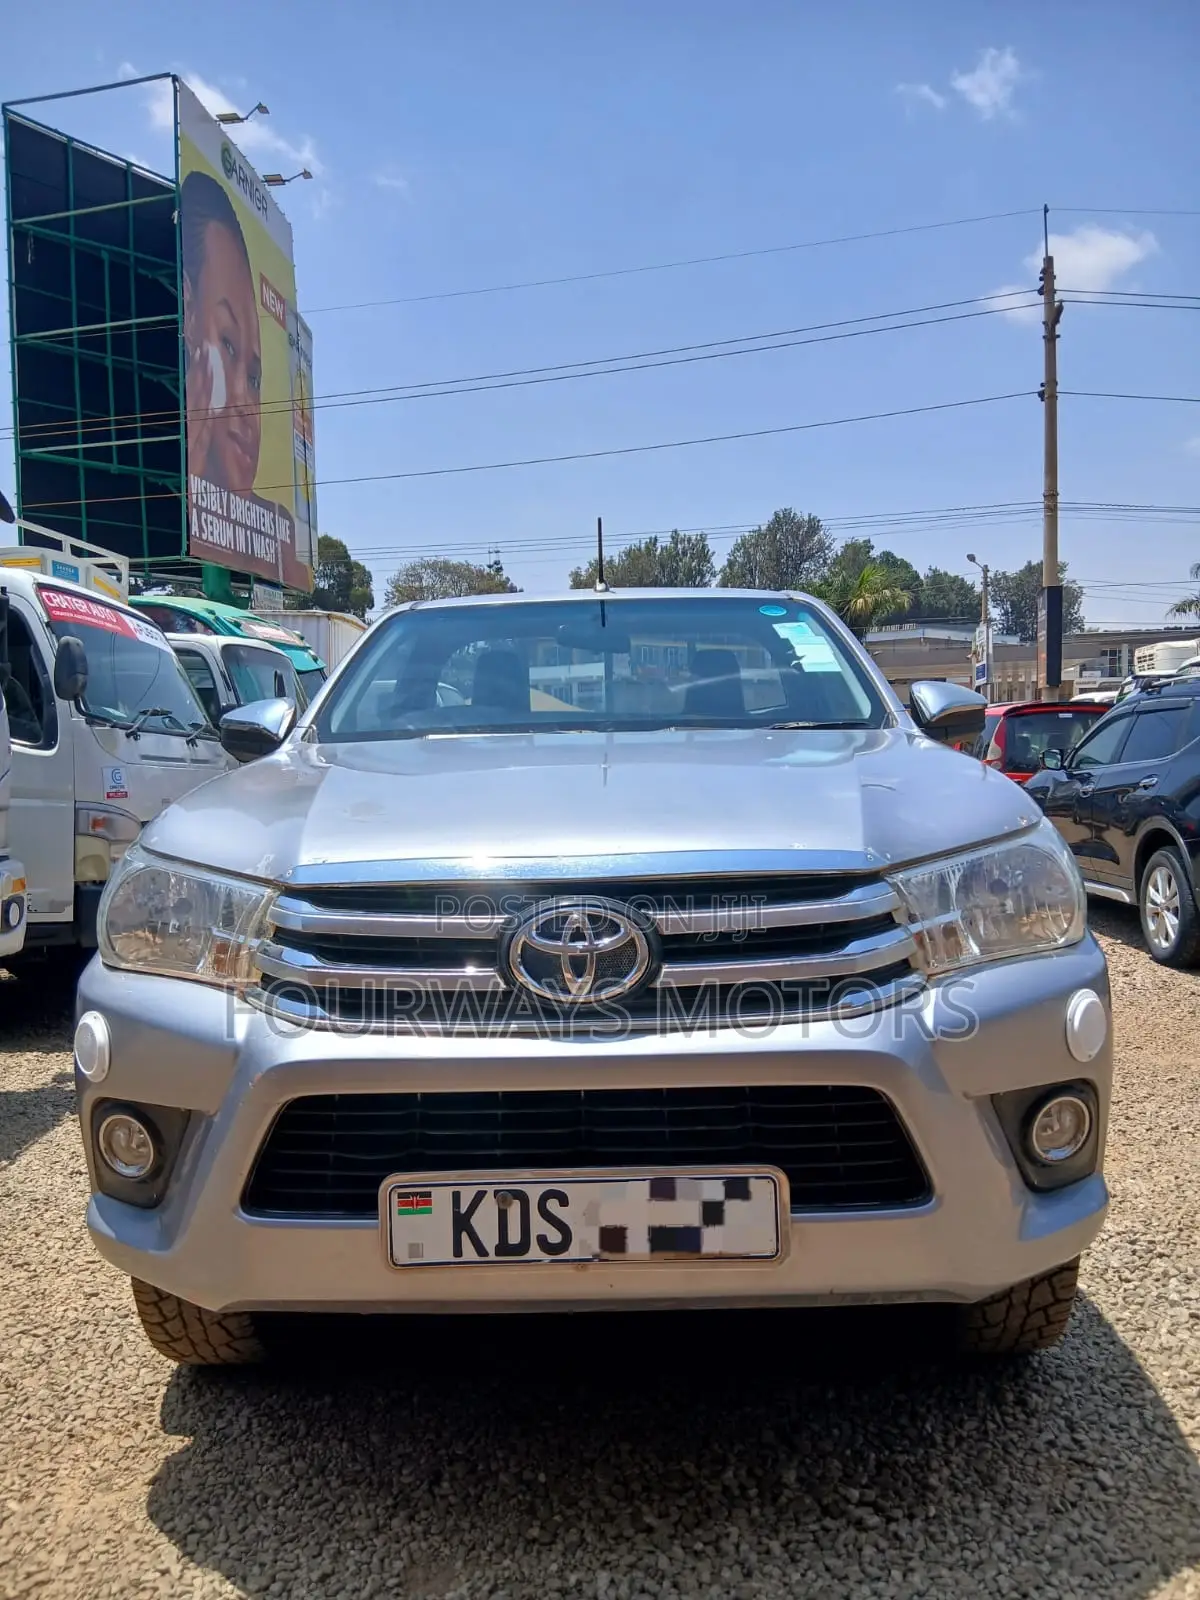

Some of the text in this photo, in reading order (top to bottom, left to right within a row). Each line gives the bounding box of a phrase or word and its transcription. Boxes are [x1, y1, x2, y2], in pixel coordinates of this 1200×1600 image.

[262, 282, 283, 320] NEW
[191, 474, 227, 516] VISIBLY
[230, 492, 275, 536] BRIGHTENS
[192, 508, 199, 537] A
[201, 512, 234, 550] SERUM
[236, 525, 246, 553] IN
[247, 530, 252, 555] 1
[252, 532, 276, 564] WASH
[42, 591, 91, 614] CRATER
[452, 1188, 572, 1258] KDS
